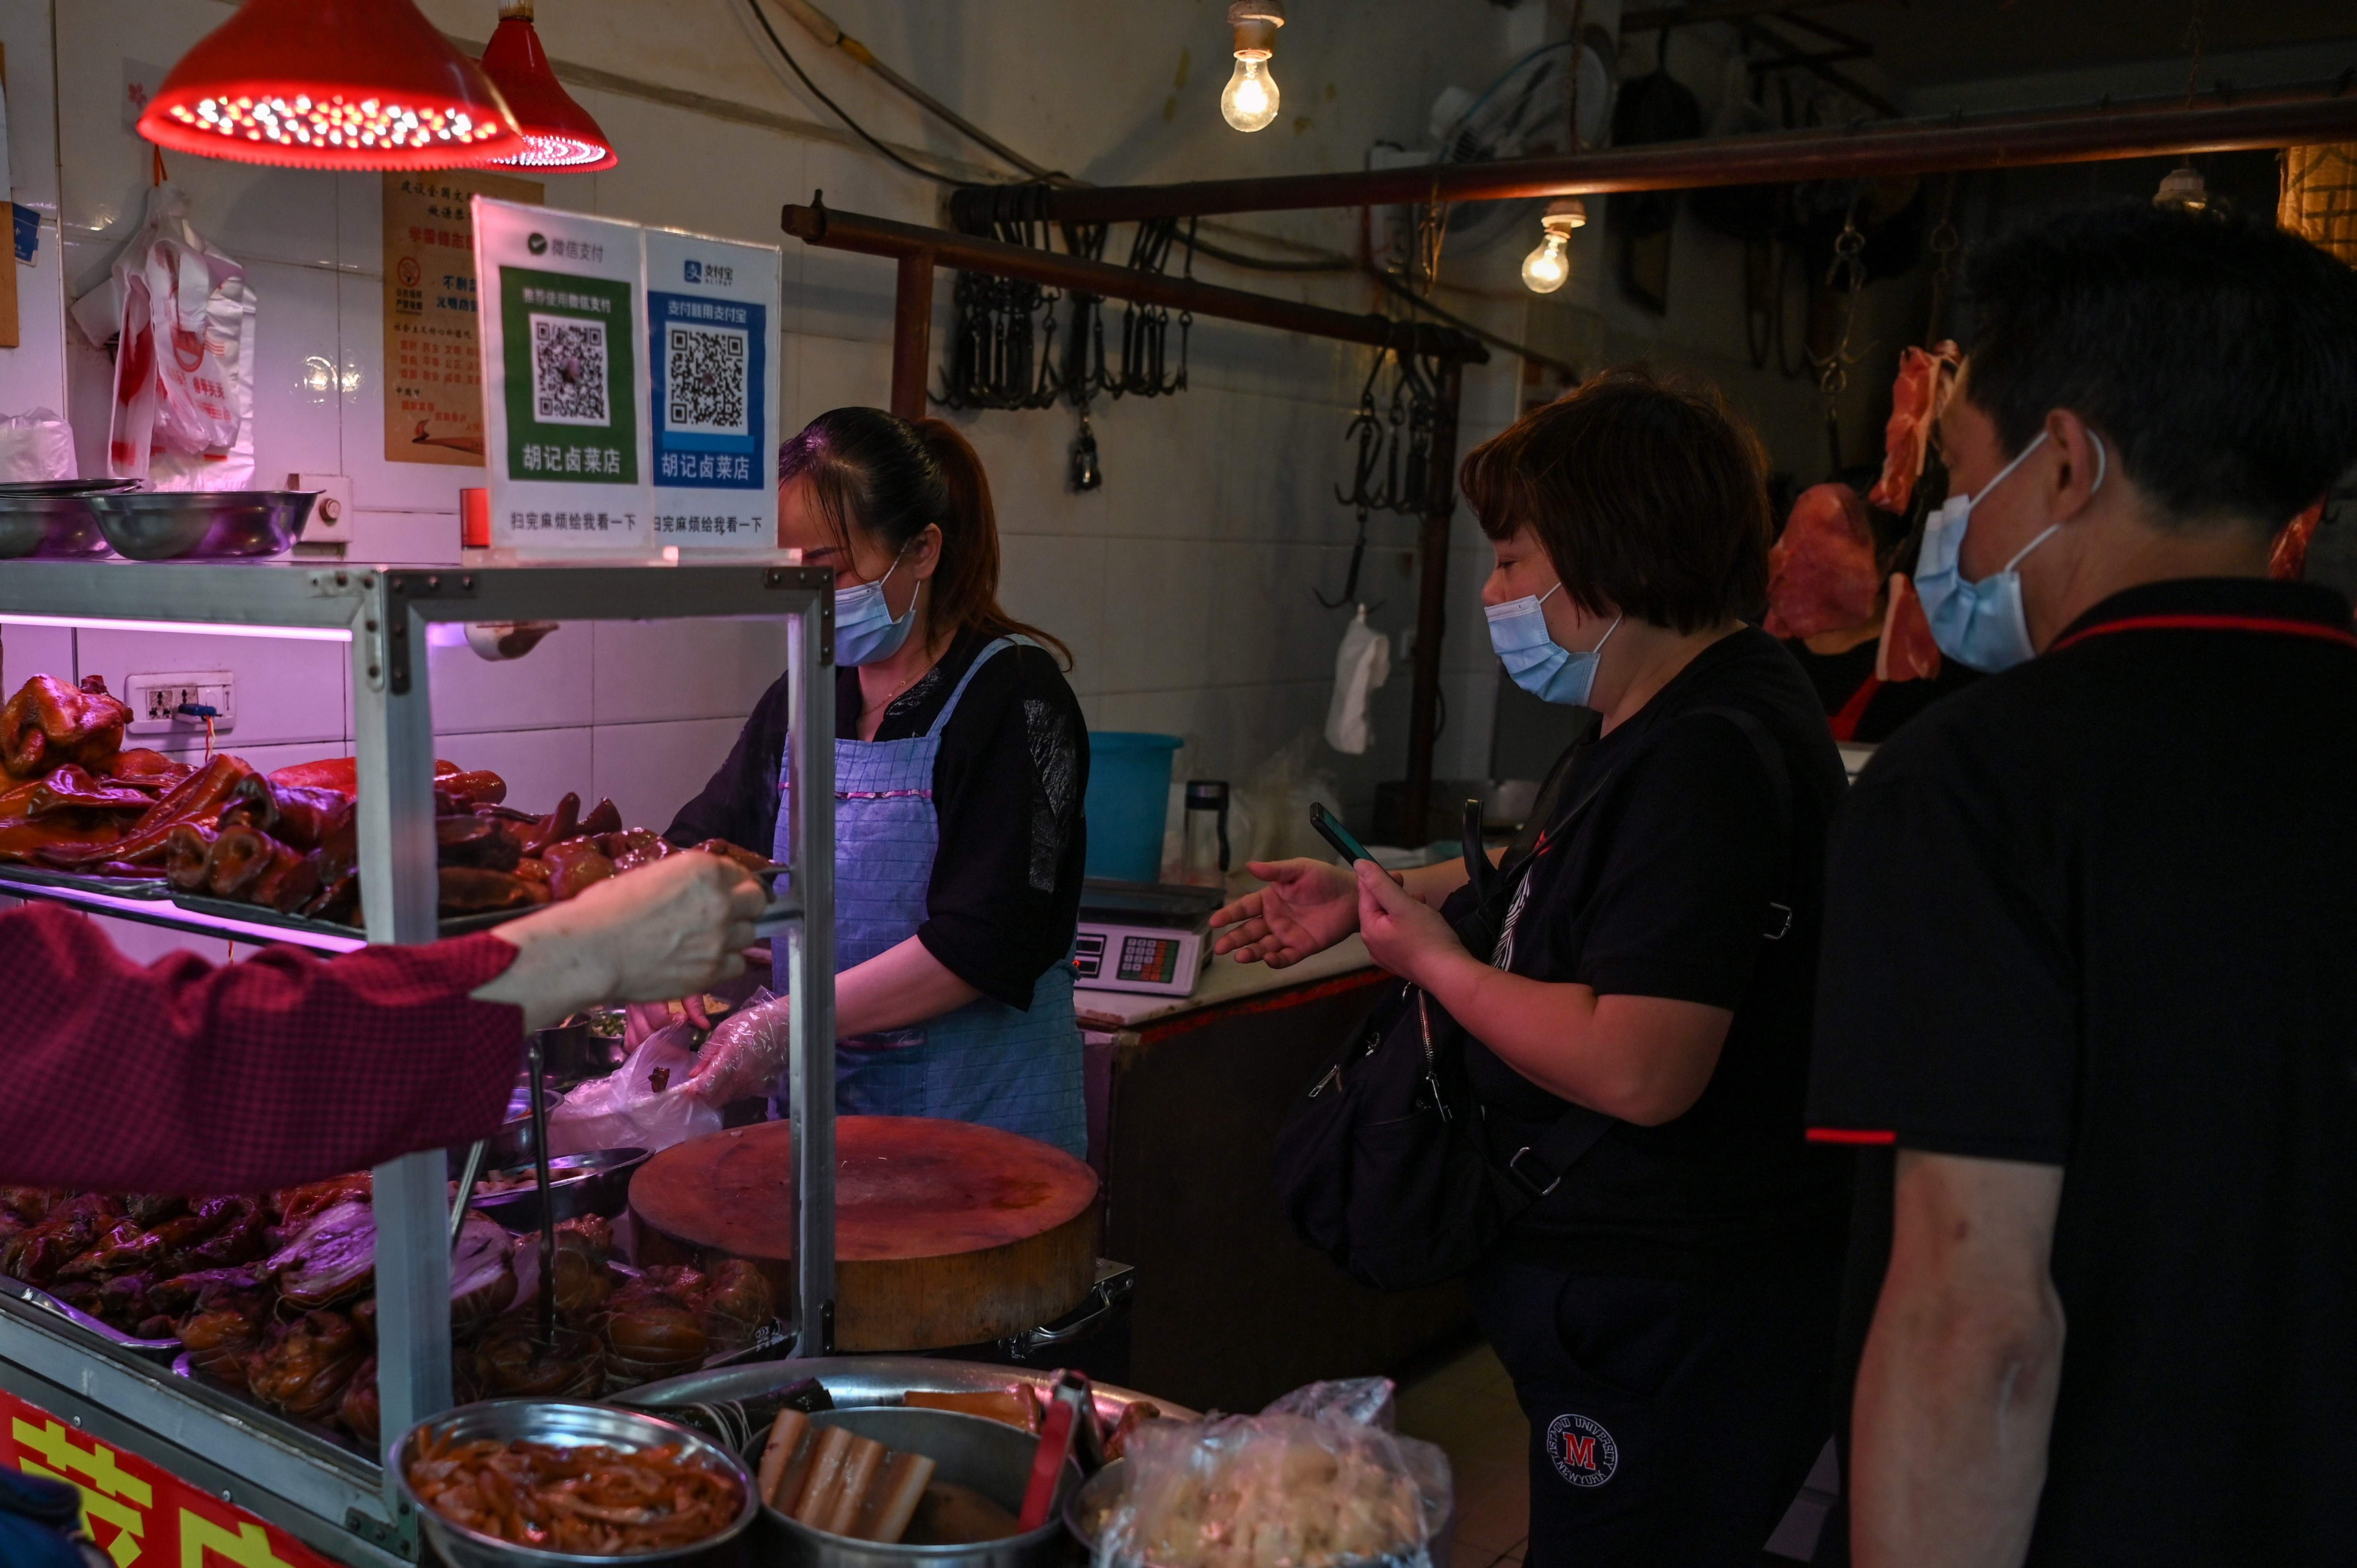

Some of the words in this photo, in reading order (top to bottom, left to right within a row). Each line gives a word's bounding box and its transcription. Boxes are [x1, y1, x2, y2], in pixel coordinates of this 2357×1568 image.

[552, 238, 603, 263] 微信支付
[705, 265, 733, 281] 支付宝
[705, 278, 732, 287] ALIPAY
[523, 287, 611, 313] 推荐使用微信支付
[668, 300, 747, 323] 支付就用支付宝
[523, 444, 621, 475] 胡记卤菜店
[661, 452, 749, 480] 胡记卤菜店
[511, 511, 636, 531] 扫完麻烦给我看一下
[1562, 1431, 1596, 1471] M
[1574, 1417, 1615, 1471] UNIVERSITY
